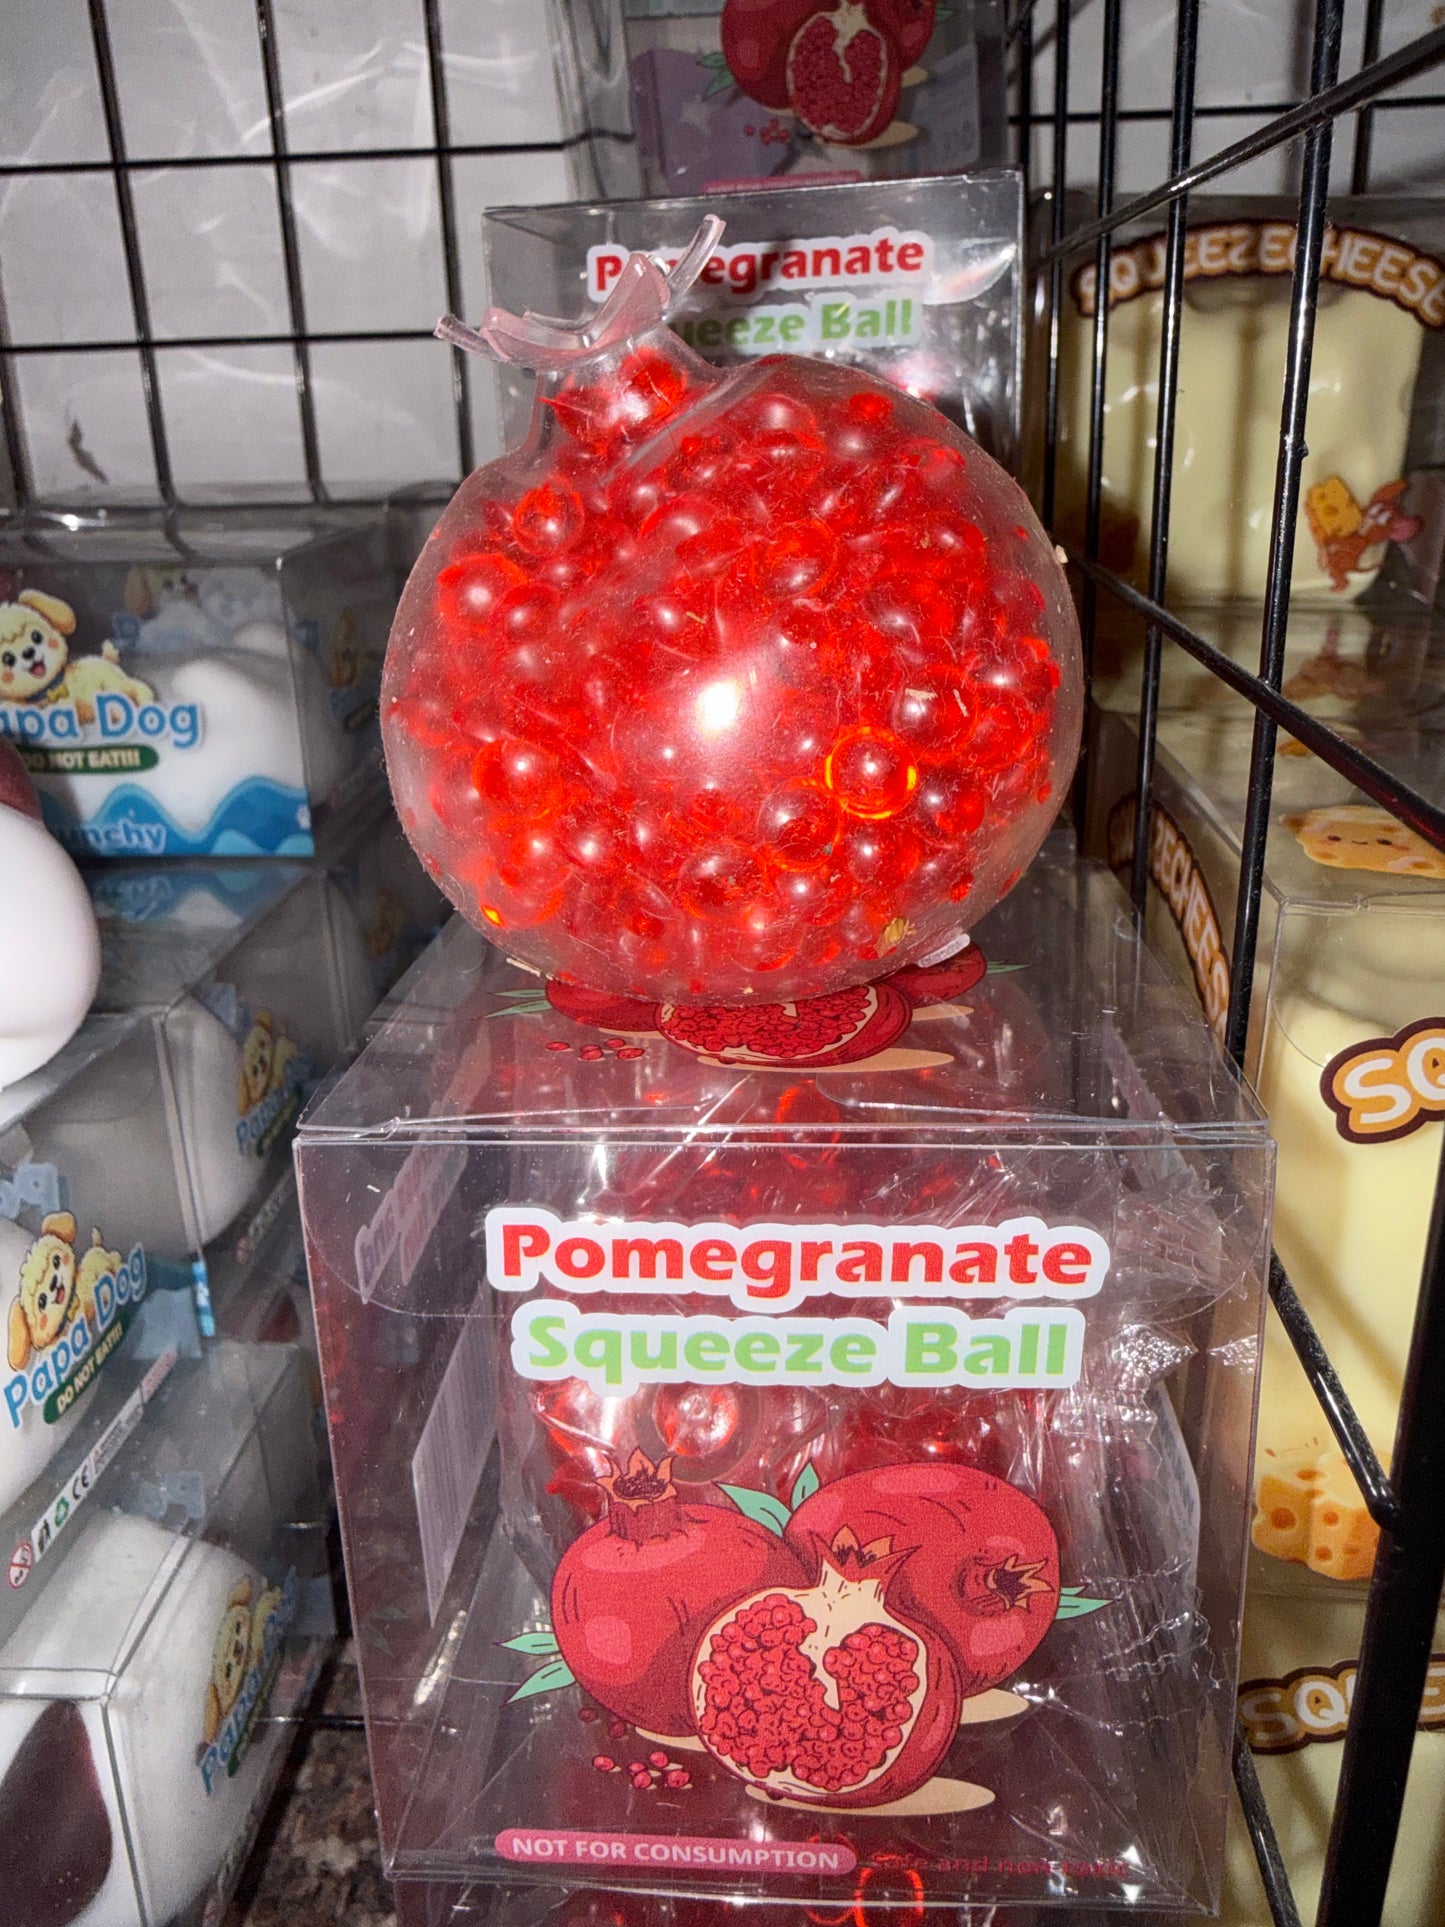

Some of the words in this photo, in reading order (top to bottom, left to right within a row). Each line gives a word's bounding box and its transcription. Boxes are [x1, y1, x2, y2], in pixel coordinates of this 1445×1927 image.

[595, 237, 926, 294] Pegranate
[821, 298, 914, 339] Ball
[96, 694, 199, 749] Dog
[501, 1223, 1092, 1298] Pomegranate
[3, 1317, 91, 1428] Papa
[94, 1247, 146, 1327] Dog
[528, 1316, 877, 1385] Squeeze
[904, 1321, 1067, 1375] Ball
[57, 1385, 75, 1414] DO
[512, 1837, 568, 1858] NOT
[575, 1841, 627, 1859] FOR
[633, 1843, 838, 1869] CONSUMPTION
